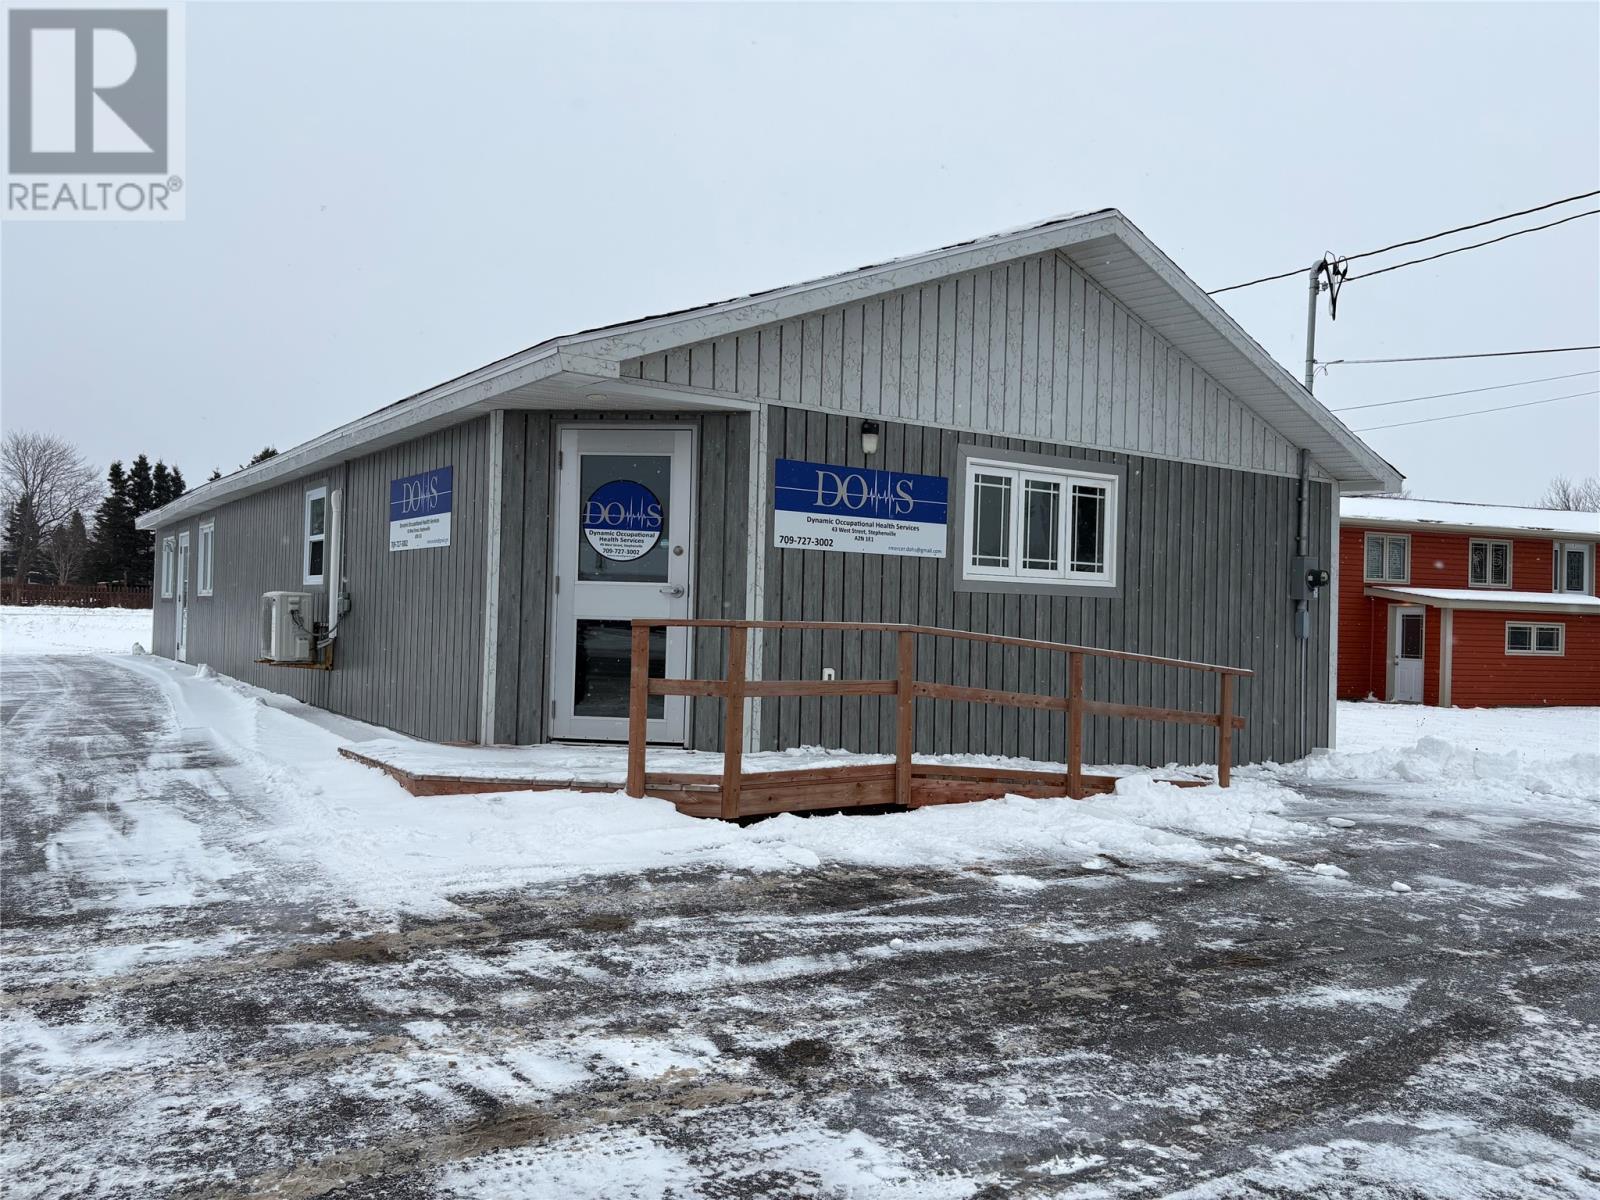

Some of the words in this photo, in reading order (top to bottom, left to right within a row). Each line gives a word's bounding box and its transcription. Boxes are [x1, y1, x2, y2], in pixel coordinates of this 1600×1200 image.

[806, 516, 834, 525] Dynamic
[835, 519, 874, 527] Occupational
[875, 522, 896, 530] Health
[896, 523, 920, 532] Services
[868, 529, 897, 537] Stephenville
[779, 535, 834, 547] 709-727-3002
